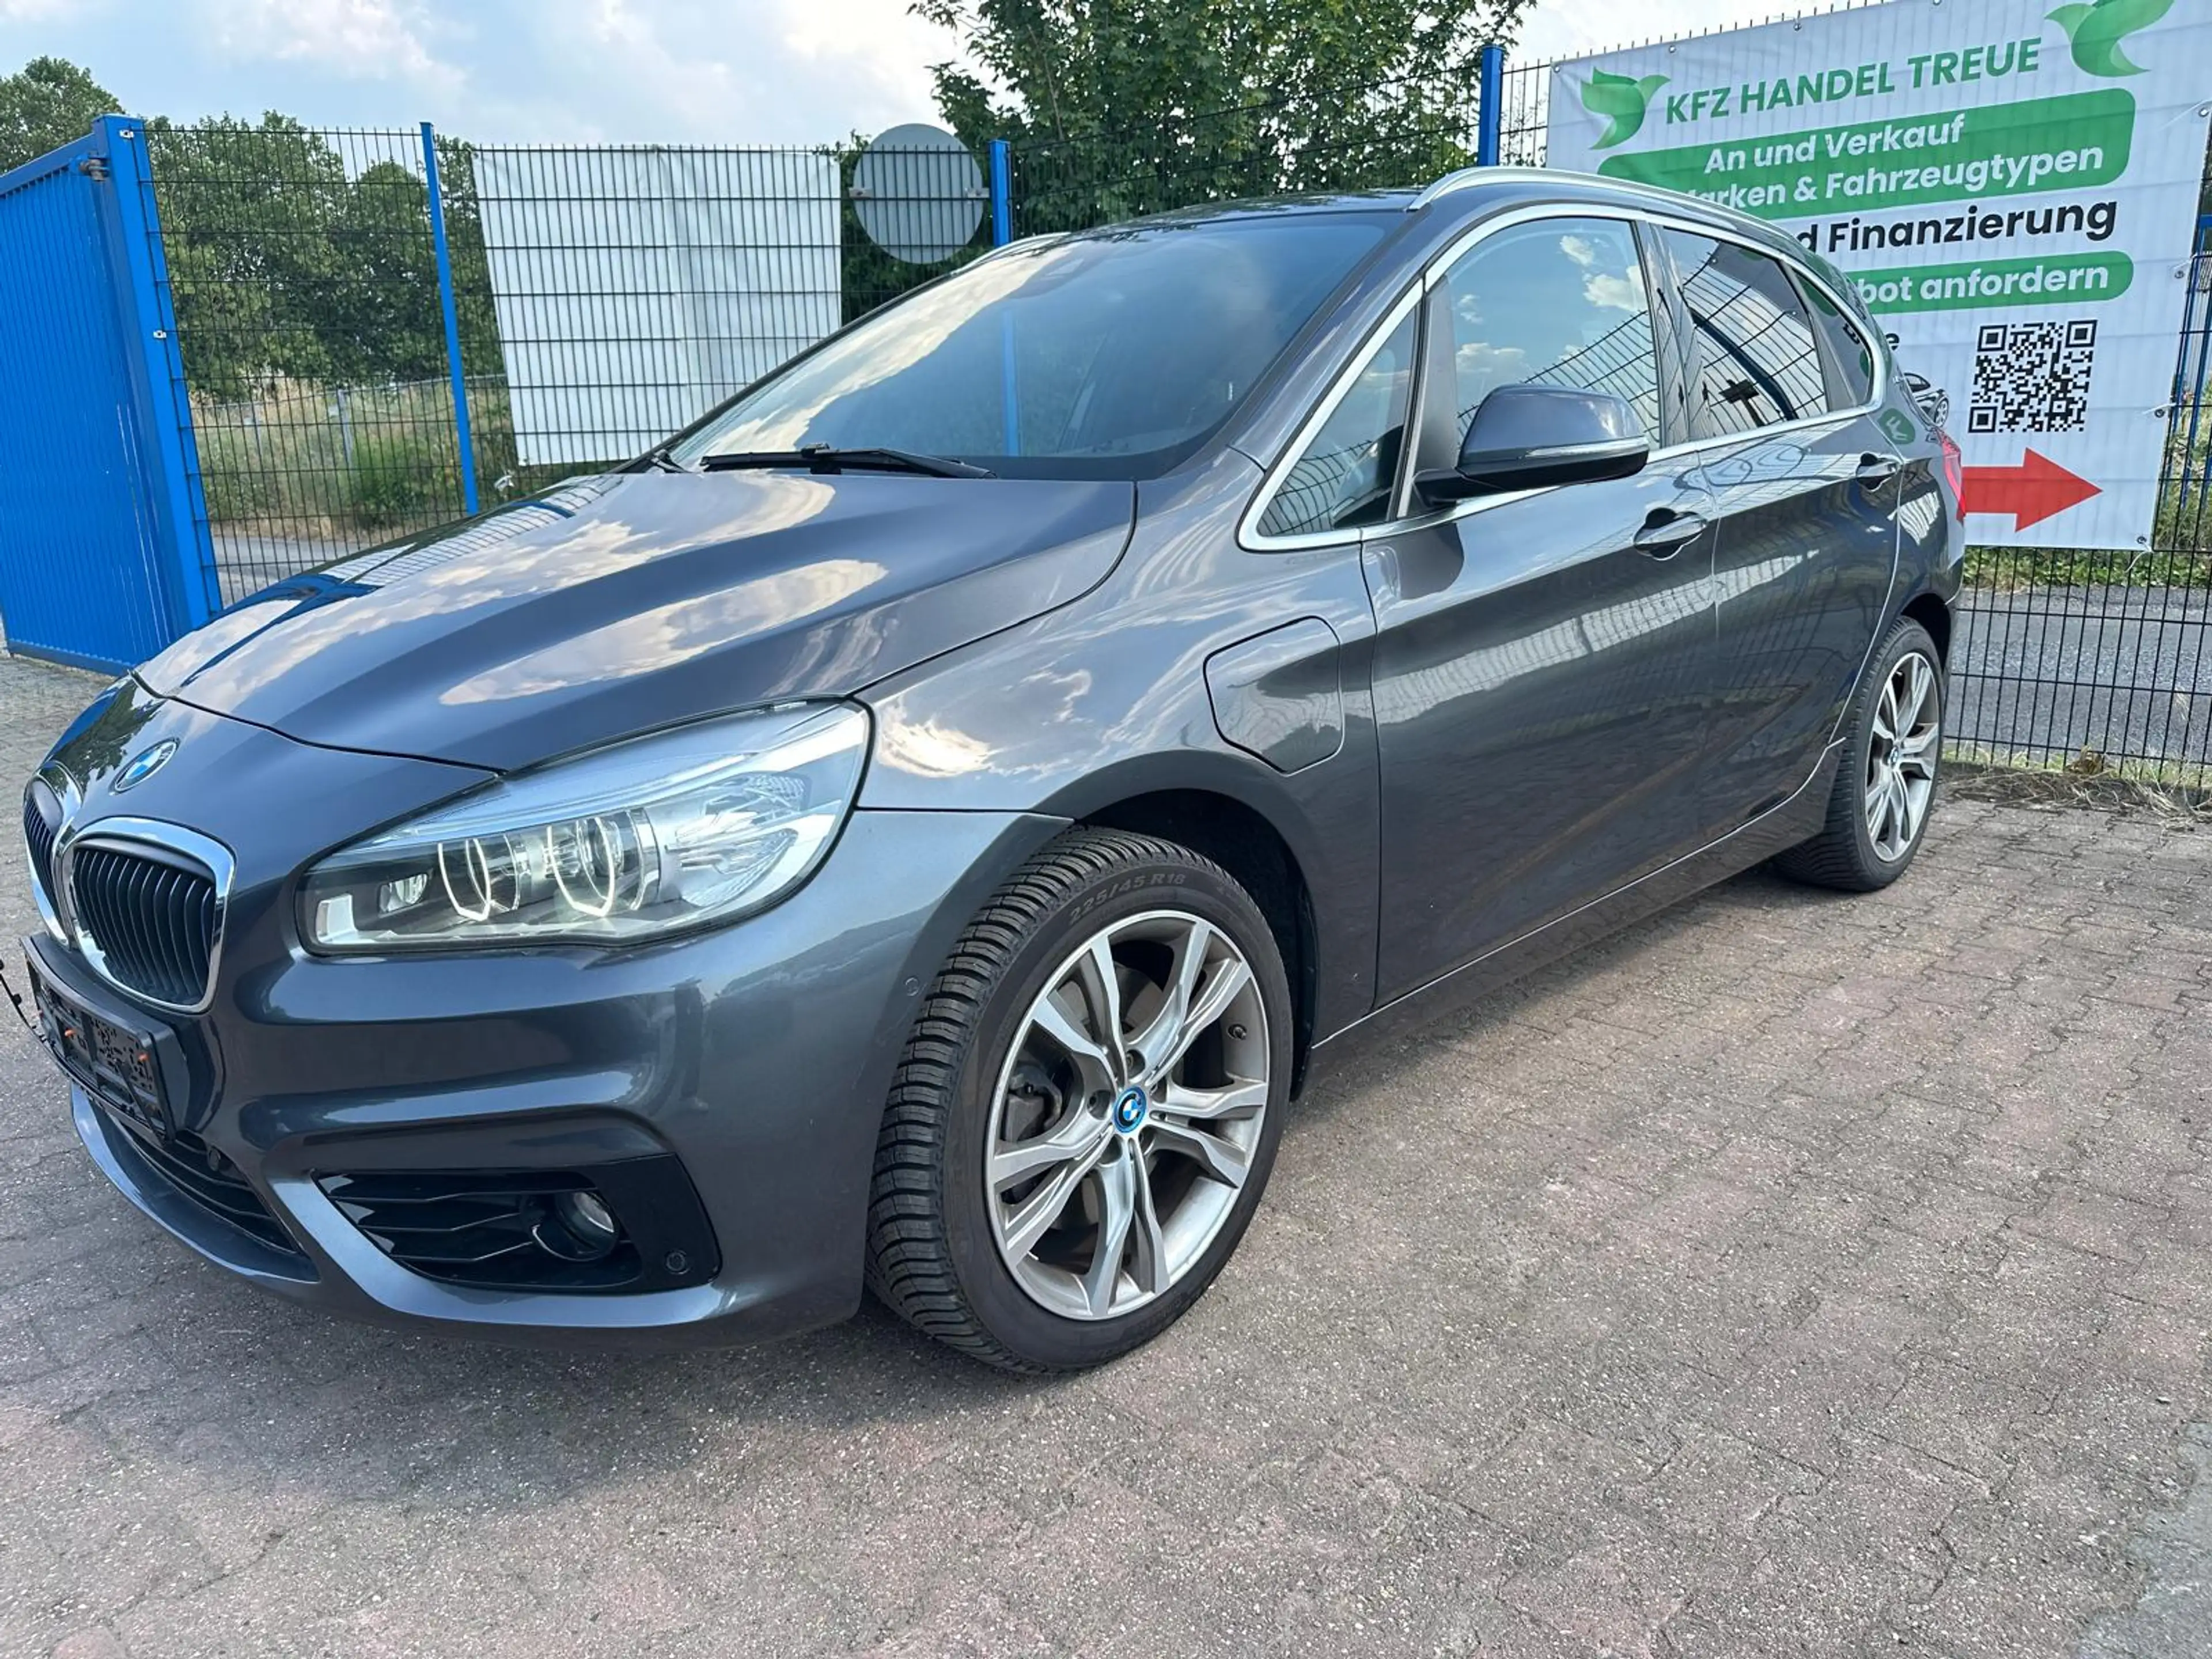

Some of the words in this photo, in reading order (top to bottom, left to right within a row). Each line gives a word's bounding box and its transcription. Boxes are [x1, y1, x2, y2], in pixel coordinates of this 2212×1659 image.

[1666, 87, 1731, 124] KFZ
[1740, 62, 1895, 115] HANDEL
[1907, 37, 2041, 89] TREUE
[1703, 148, 1747, 174] An
[1753, 134, 1817, 167] und
[1825, 113, 1965, 158] Verkauf
[1793, 176, 1818, 202] &
[1825, 146, 2104, 199] Fahrzeugtypen
[1828, 200, 2118, 252] Finanzierung
[1919, 265, 2109, 300] anfordern
[1070, 875, 1146, 923] 225/45
